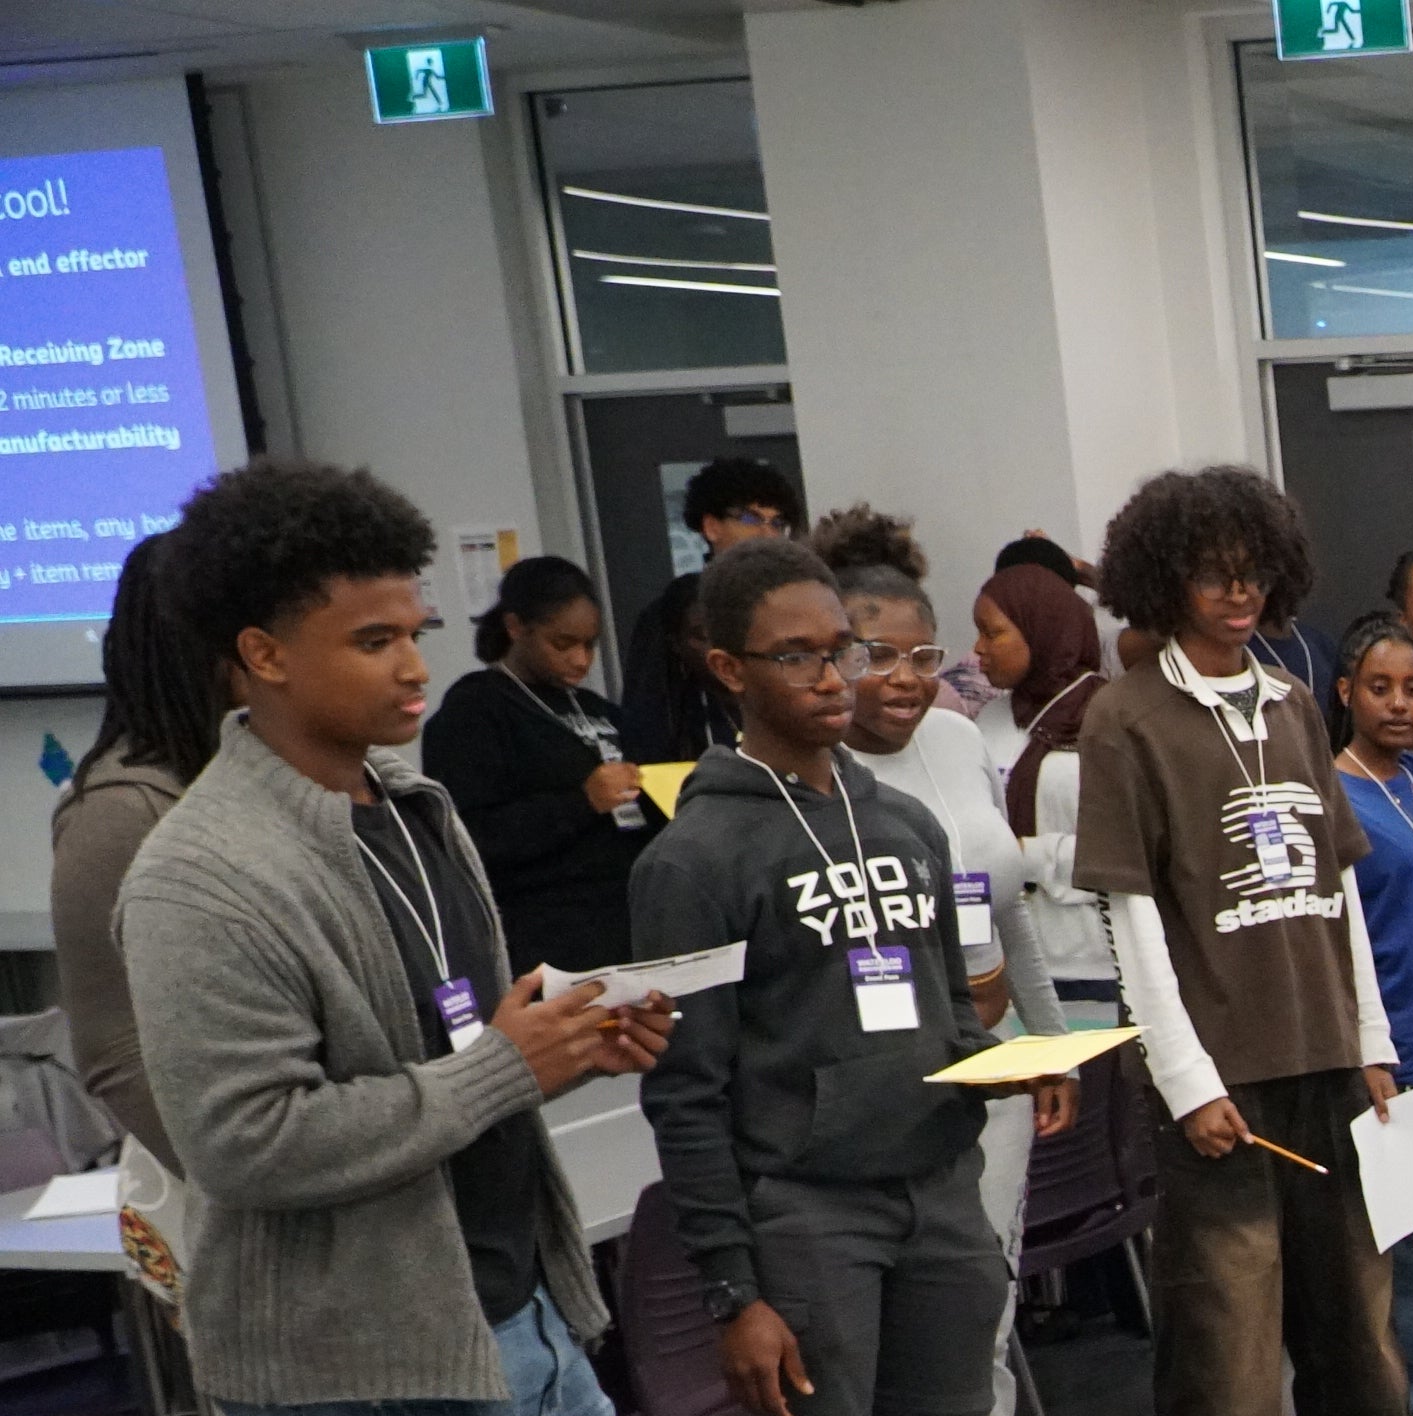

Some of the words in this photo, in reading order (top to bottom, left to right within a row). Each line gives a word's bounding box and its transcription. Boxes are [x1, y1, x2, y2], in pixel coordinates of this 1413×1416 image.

[0, 177, 71, 221] ool!
[8, 252, 52, 276] end
[56, 247, 149, 273] effector
[0, 340, 104, 366] Receiving
[106, 336, 165, 360] Zone
[13, 386, 98, 410] minutes
[101, 386, 124, 406] or
[126, 380, 170, 405] less
[787, 856, 908, 912] ZOO
[799, 893, 937, 946] YORK
